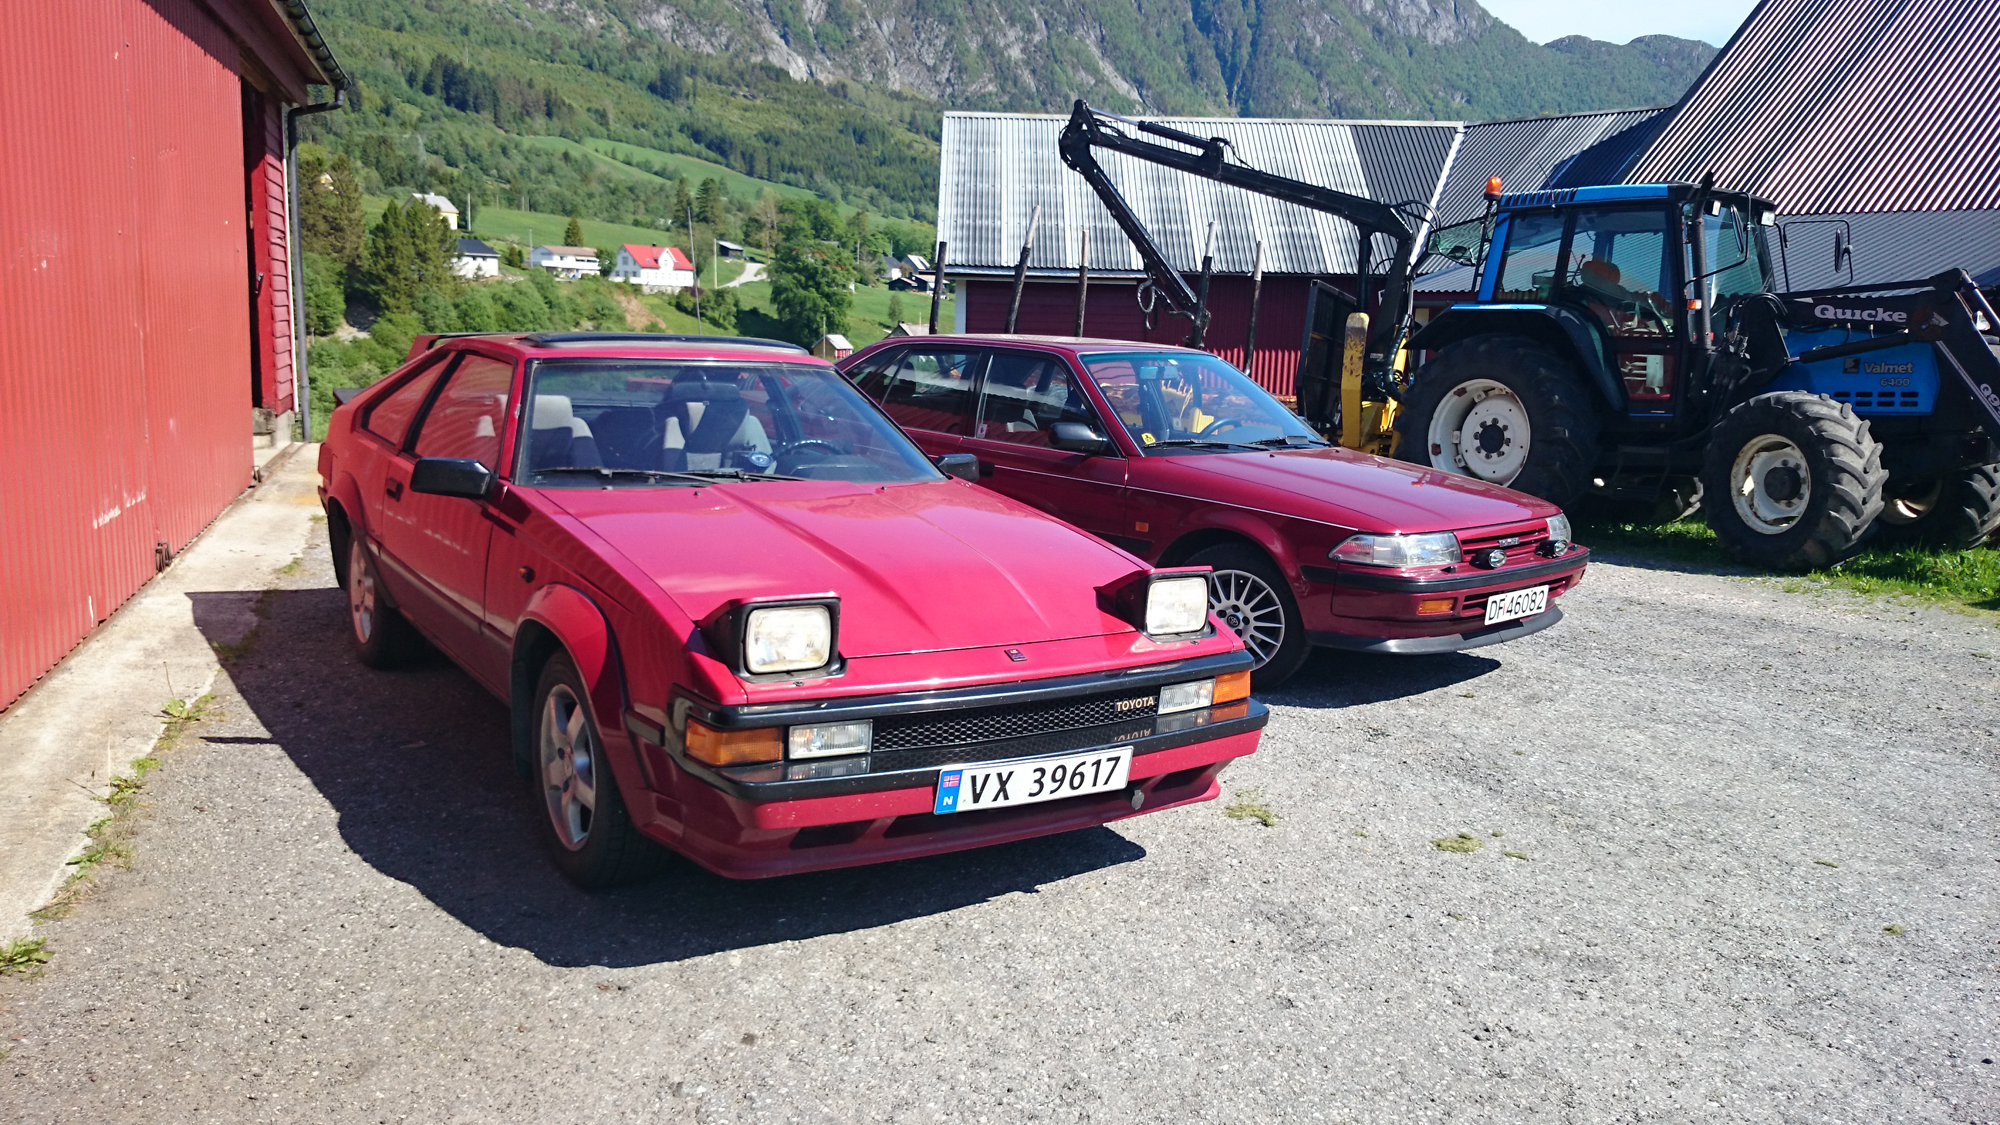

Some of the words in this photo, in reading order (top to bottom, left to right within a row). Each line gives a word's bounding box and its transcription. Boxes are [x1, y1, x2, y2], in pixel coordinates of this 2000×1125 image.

[1814, 304, 1907, 323] Quicke
[1864, 361, 1913, 374] Valmet
[1880, 378, 1910, 387] 6400
[1116, 696, 1155, 712] TOYOTA
[970, 771, 1015, 804] VX
[1028, 756, 1121, 797] 39617
[943, 795, 953, 806] N
